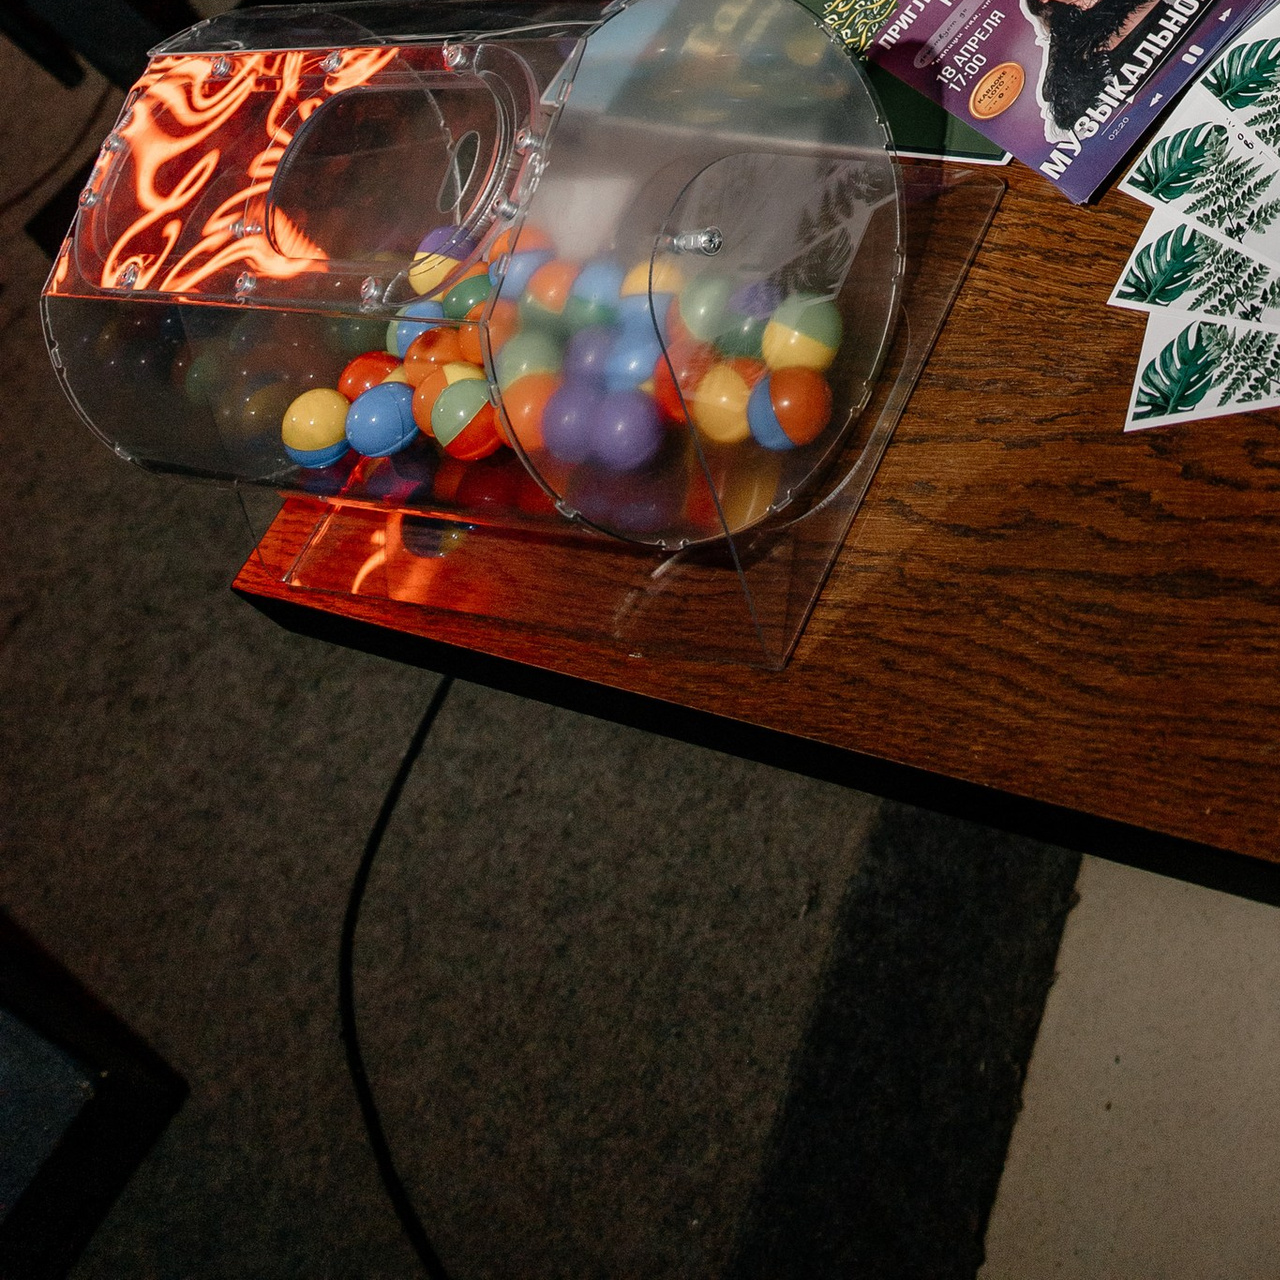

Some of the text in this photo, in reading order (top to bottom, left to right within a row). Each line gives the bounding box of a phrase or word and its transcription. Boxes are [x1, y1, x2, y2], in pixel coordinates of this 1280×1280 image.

[938, 10, 1005, 83] 18 АПРЕЛЯ
[949, 54, 987, 92] 17:00
[977, 70, 1008, 105] KARAOKE
[988, 80, 1005, 100] LOTO
